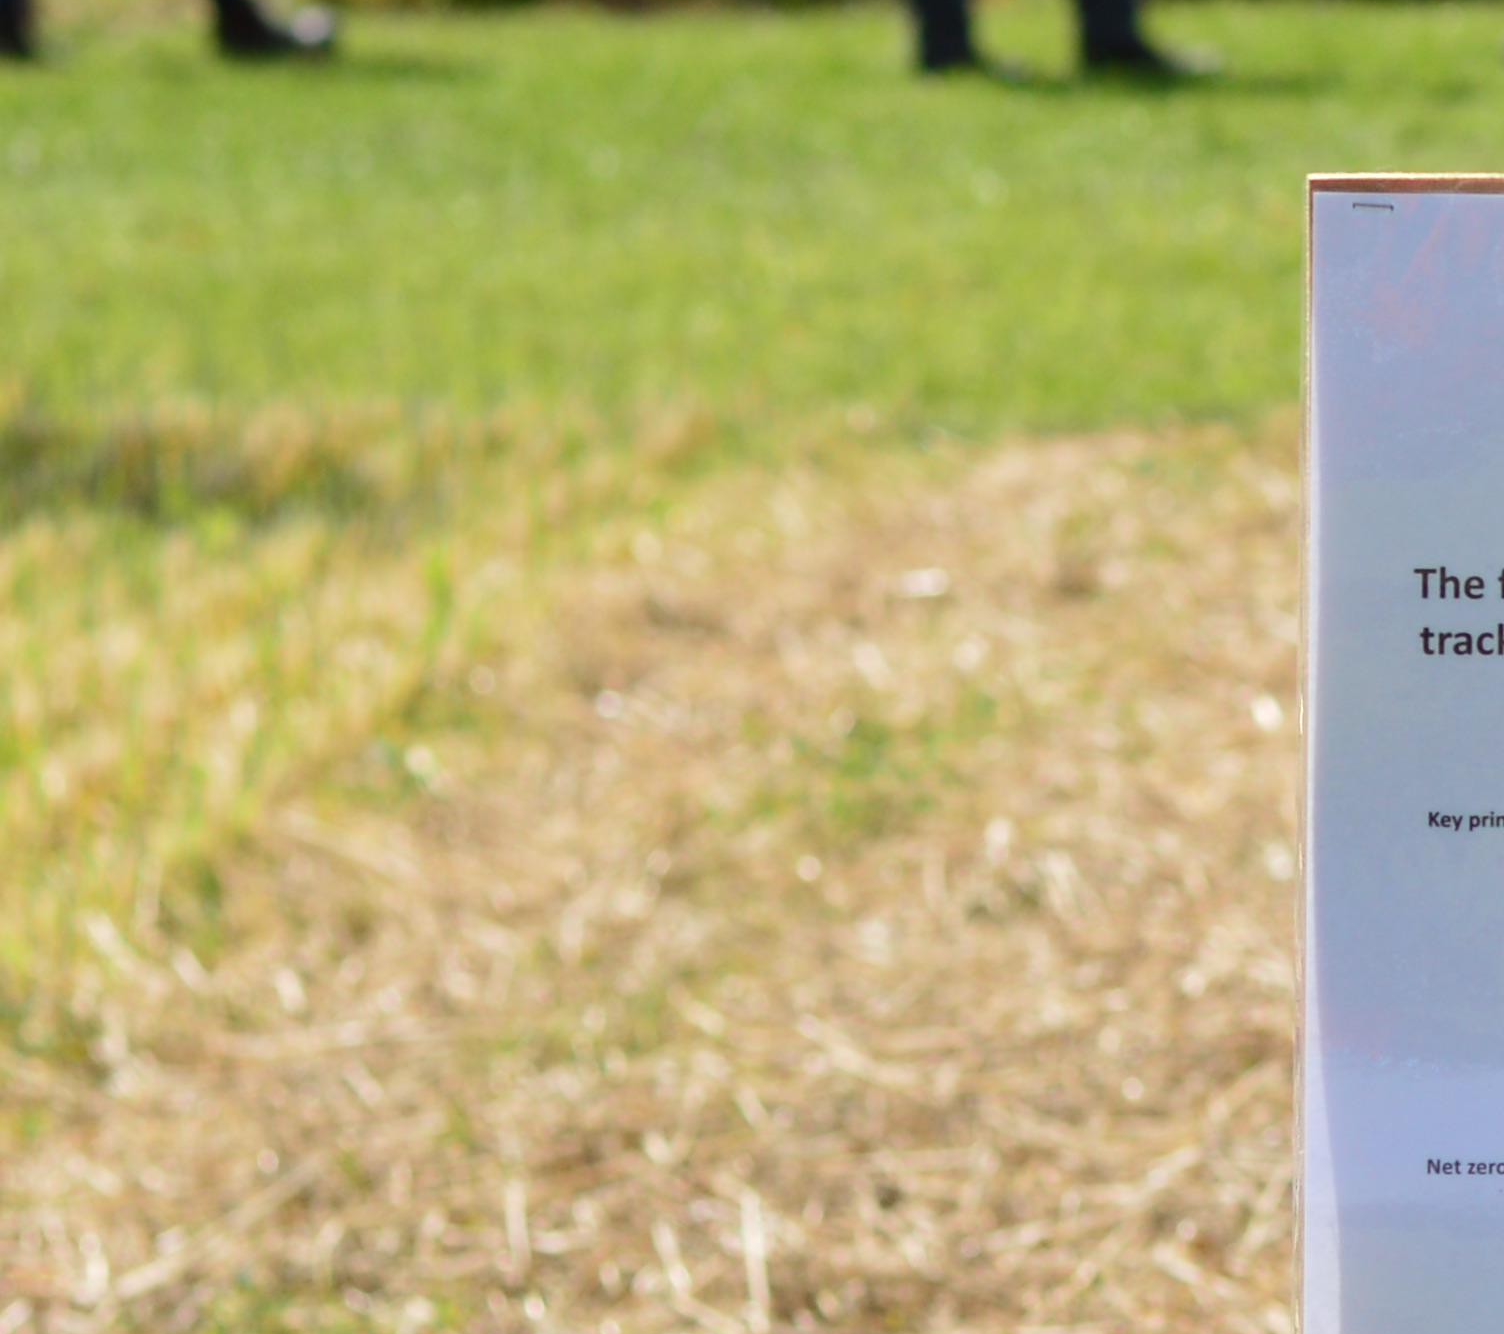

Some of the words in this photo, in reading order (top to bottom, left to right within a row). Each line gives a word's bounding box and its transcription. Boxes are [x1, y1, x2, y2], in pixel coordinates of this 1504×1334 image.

[1413, 565, 1485, 600] The
[1428, 811, 1464, 832] Key
[1426, 1158, 1462, 1176] Net
